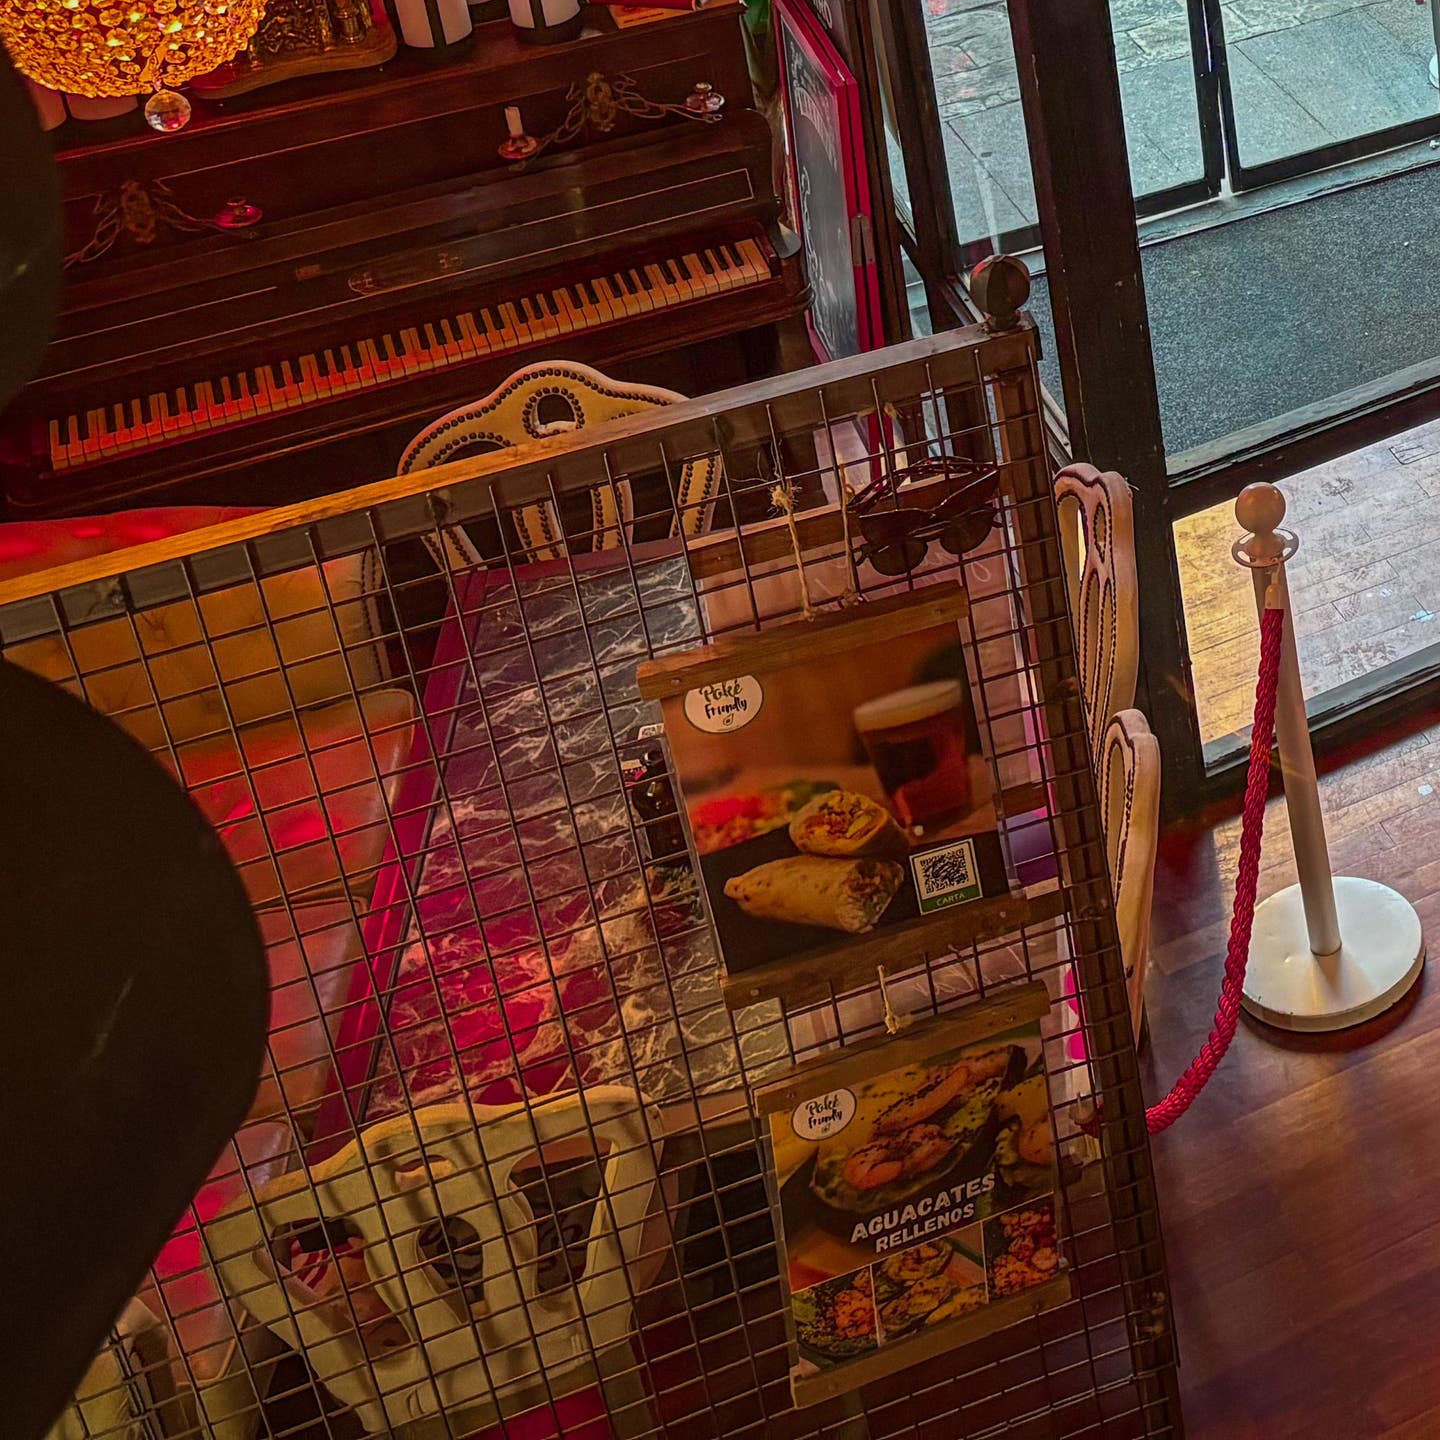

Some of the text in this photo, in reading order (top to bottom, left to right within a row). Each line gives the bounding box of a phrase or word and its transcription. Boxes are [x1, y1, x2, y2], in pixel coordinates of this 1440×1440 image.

[936, 893, 966, 906] CARTA
[850, 1173, 995, 1244] AGUACATES
[875, 1202, 975, 1253] RELLENOS
